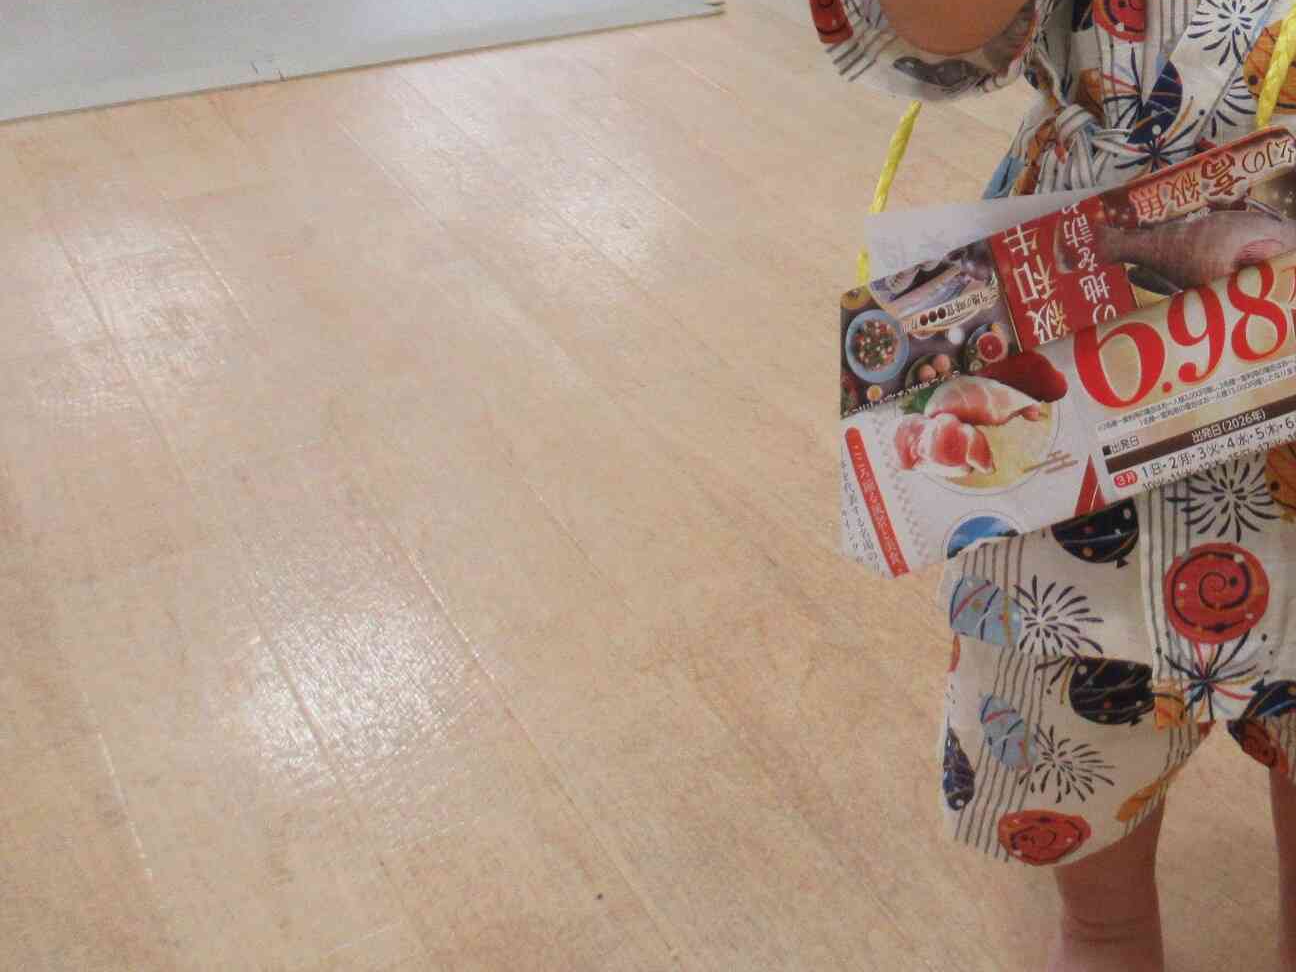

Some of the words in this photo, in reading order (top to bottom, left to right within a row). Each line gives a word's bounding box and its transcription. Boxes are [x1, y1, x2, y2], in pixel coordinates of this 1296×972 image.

[1129, 137, 1296, 221] 幻の高級魚
[1073, 260, 1288, 409] 6.98
